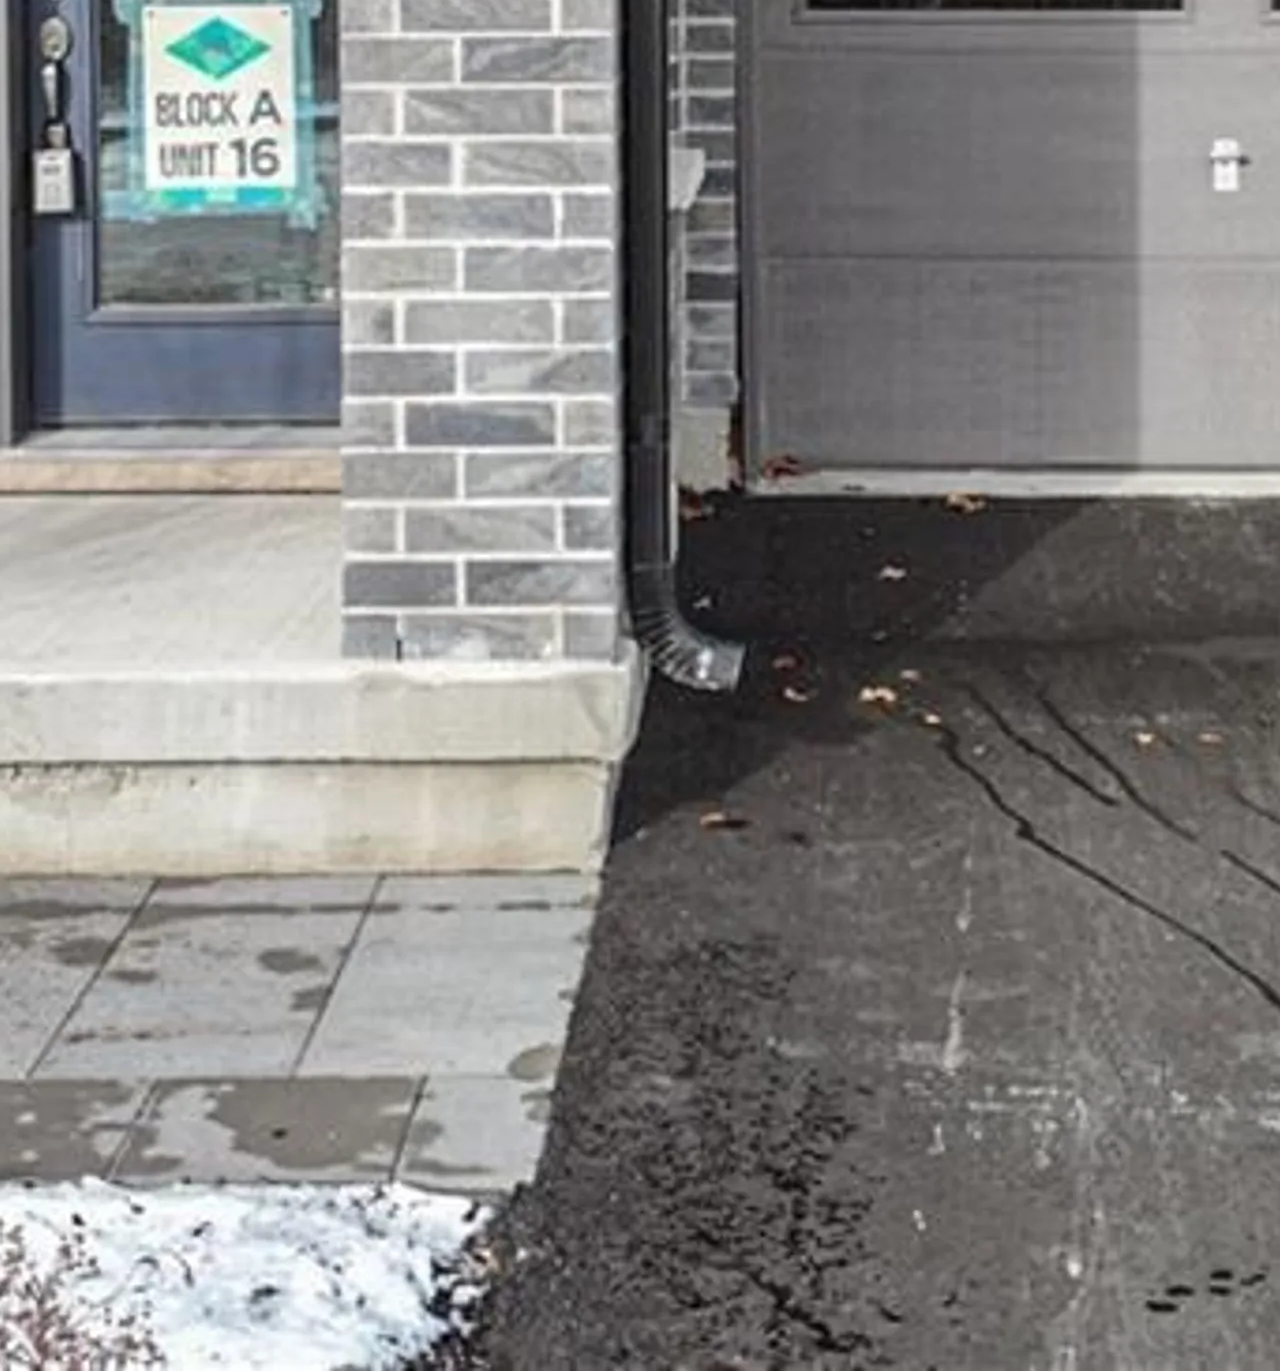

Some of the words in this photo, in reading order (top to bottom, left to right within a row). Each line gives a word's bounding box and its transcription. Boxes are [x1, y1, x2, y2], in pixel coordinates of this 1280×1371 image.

[155, 92, 239, 128] BLOCK
[250, 89, 282, 125] A
[159, 142, 220, 178] UNIT
[228, 137, 281, 178] 16
